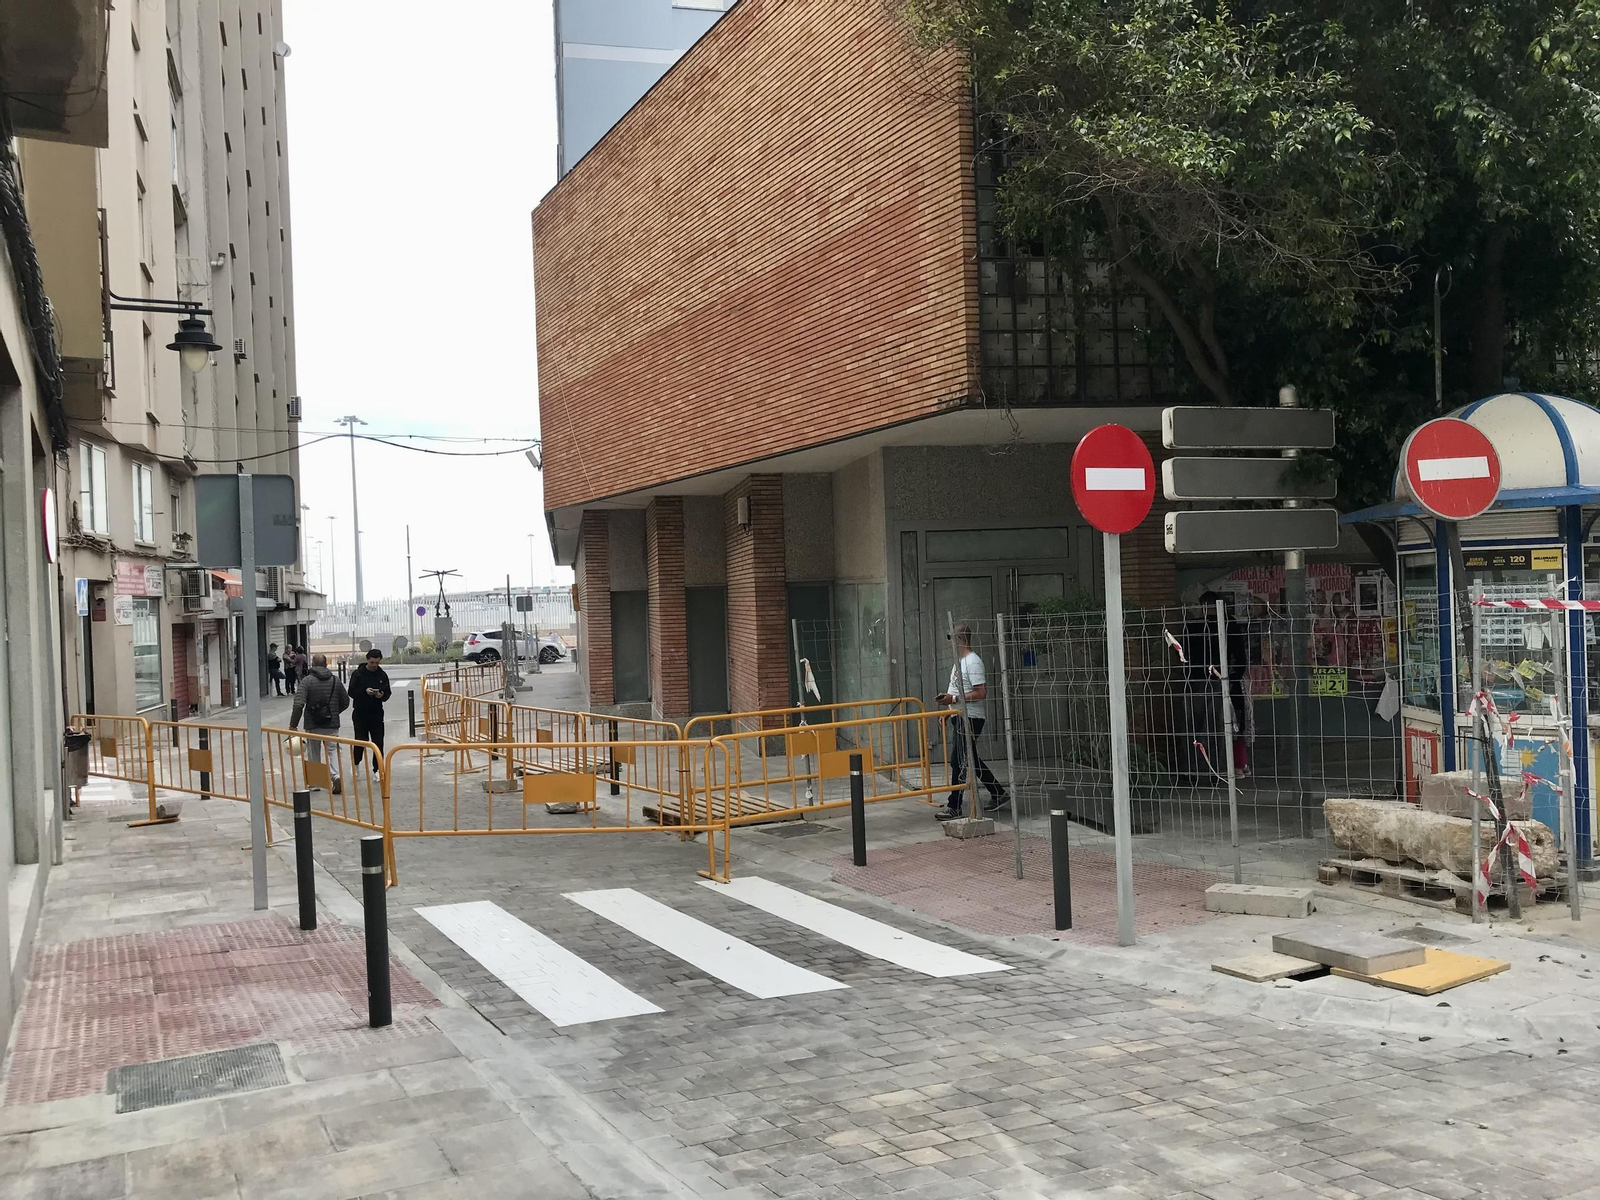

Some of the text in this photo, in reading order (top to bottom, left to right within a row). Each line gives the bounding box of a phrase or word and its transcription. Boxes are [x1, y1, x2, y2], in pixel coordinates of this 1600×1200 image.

[1509, 555, 1526, 563] 120
[1308, 563, 1341, 578] MARCA
[1328, 679, 1345, 691] 21
